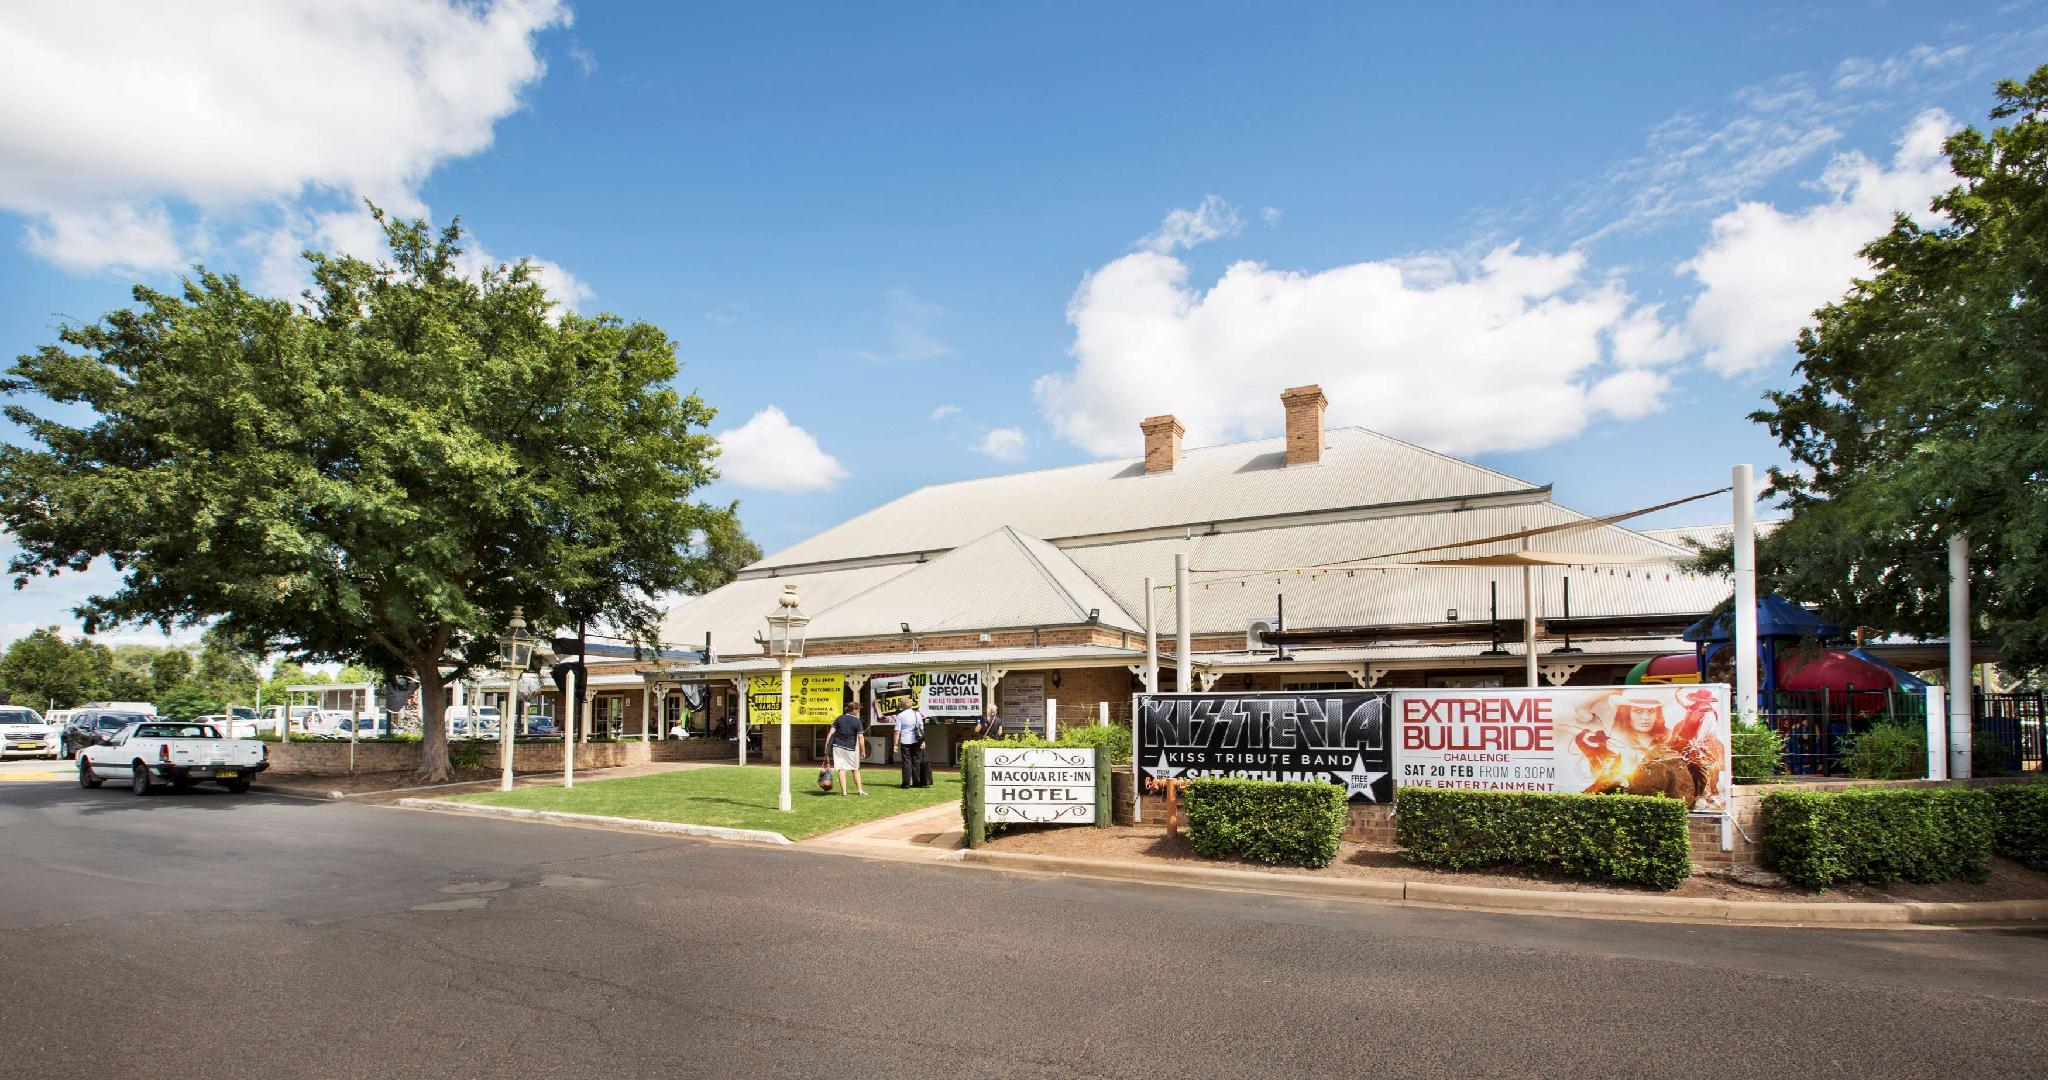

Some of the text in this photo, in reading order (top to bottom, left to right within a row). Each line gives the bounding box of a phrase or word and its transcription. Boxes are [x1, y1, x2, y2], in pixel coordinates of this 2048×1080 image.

[908, 673, 978, 687] $10 LUNCH
[929, 685, 979, 696] SPECIAL
[754, 694, 782, 704] TRIBUT
[1403, 698, 1553, 723] EXTREME
[1144, 698, 1384, 751] KISSTERIA
[1403, 725, 1554, 751] BULLRIDE
[1169, 753, 1353, 766] KISS TRIBUTE BAND
[1444, 753, 1511, 762] CHALLENGE
[991, 771, 1091, 782] MACQUARIE-INN
[1187, 768, 1224, 780] SAT
[1282, 770, 1332, 785] MAR
[1404, 764, 1555, 779] SAT 20 FEB FROM 6.30PM
[1351, 774, 1368, 783] FREE
[1404, 779, 1555, 792] LIVE ENTERTAINMENT
[1001, 788, 1078, 801] HOTEL
